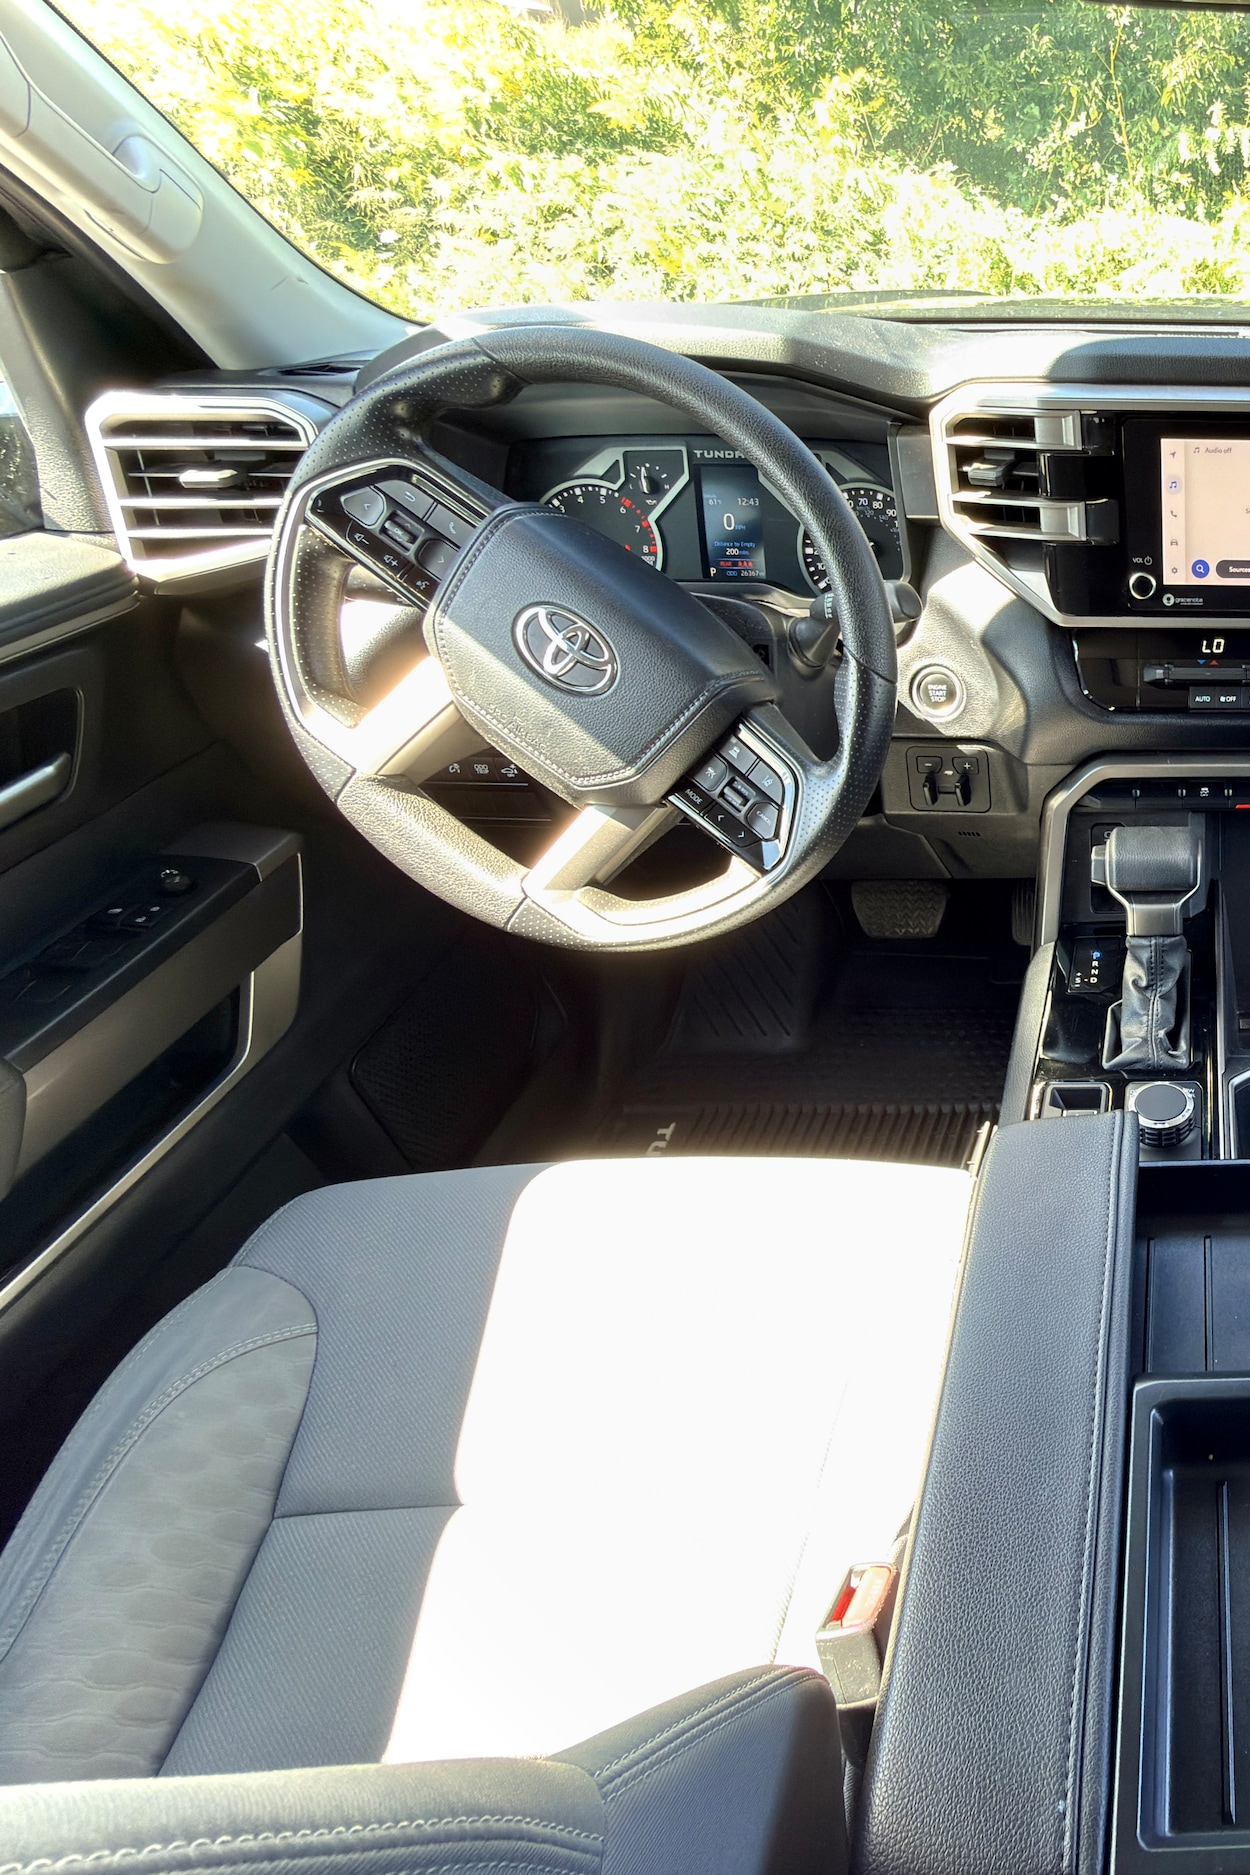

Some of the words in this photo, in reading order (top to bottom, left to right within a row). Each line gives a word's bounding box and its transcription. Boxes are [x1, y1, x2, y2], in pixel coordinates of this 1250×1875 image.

[693, 450, 746, 459] TUNDR
[577, 496, 584, 504] 4
[600, 496, 606, 504] 5
[737, 498, 760, 506] 12:43
[858, 498, 868, 506] 70
[560, 505, 566, 513] 3
[872, 501, 883, 509] 80
[620, 506, 626, 514] 6
[886, 509, 897, 517] 90
[723, 513, 735, 530] 0
[635, 525, 641, 533] 7
[643, 545, 649, 553] 8
[726, 548, 739, 556] 200
[710, 567, 717, 577] P
[1229, 566, 1250, 574] Sources
[1202, 638, 1225, 653] LO
[685, 788, 703, 805] MODE
[1093, 951, 1100, 959] P
